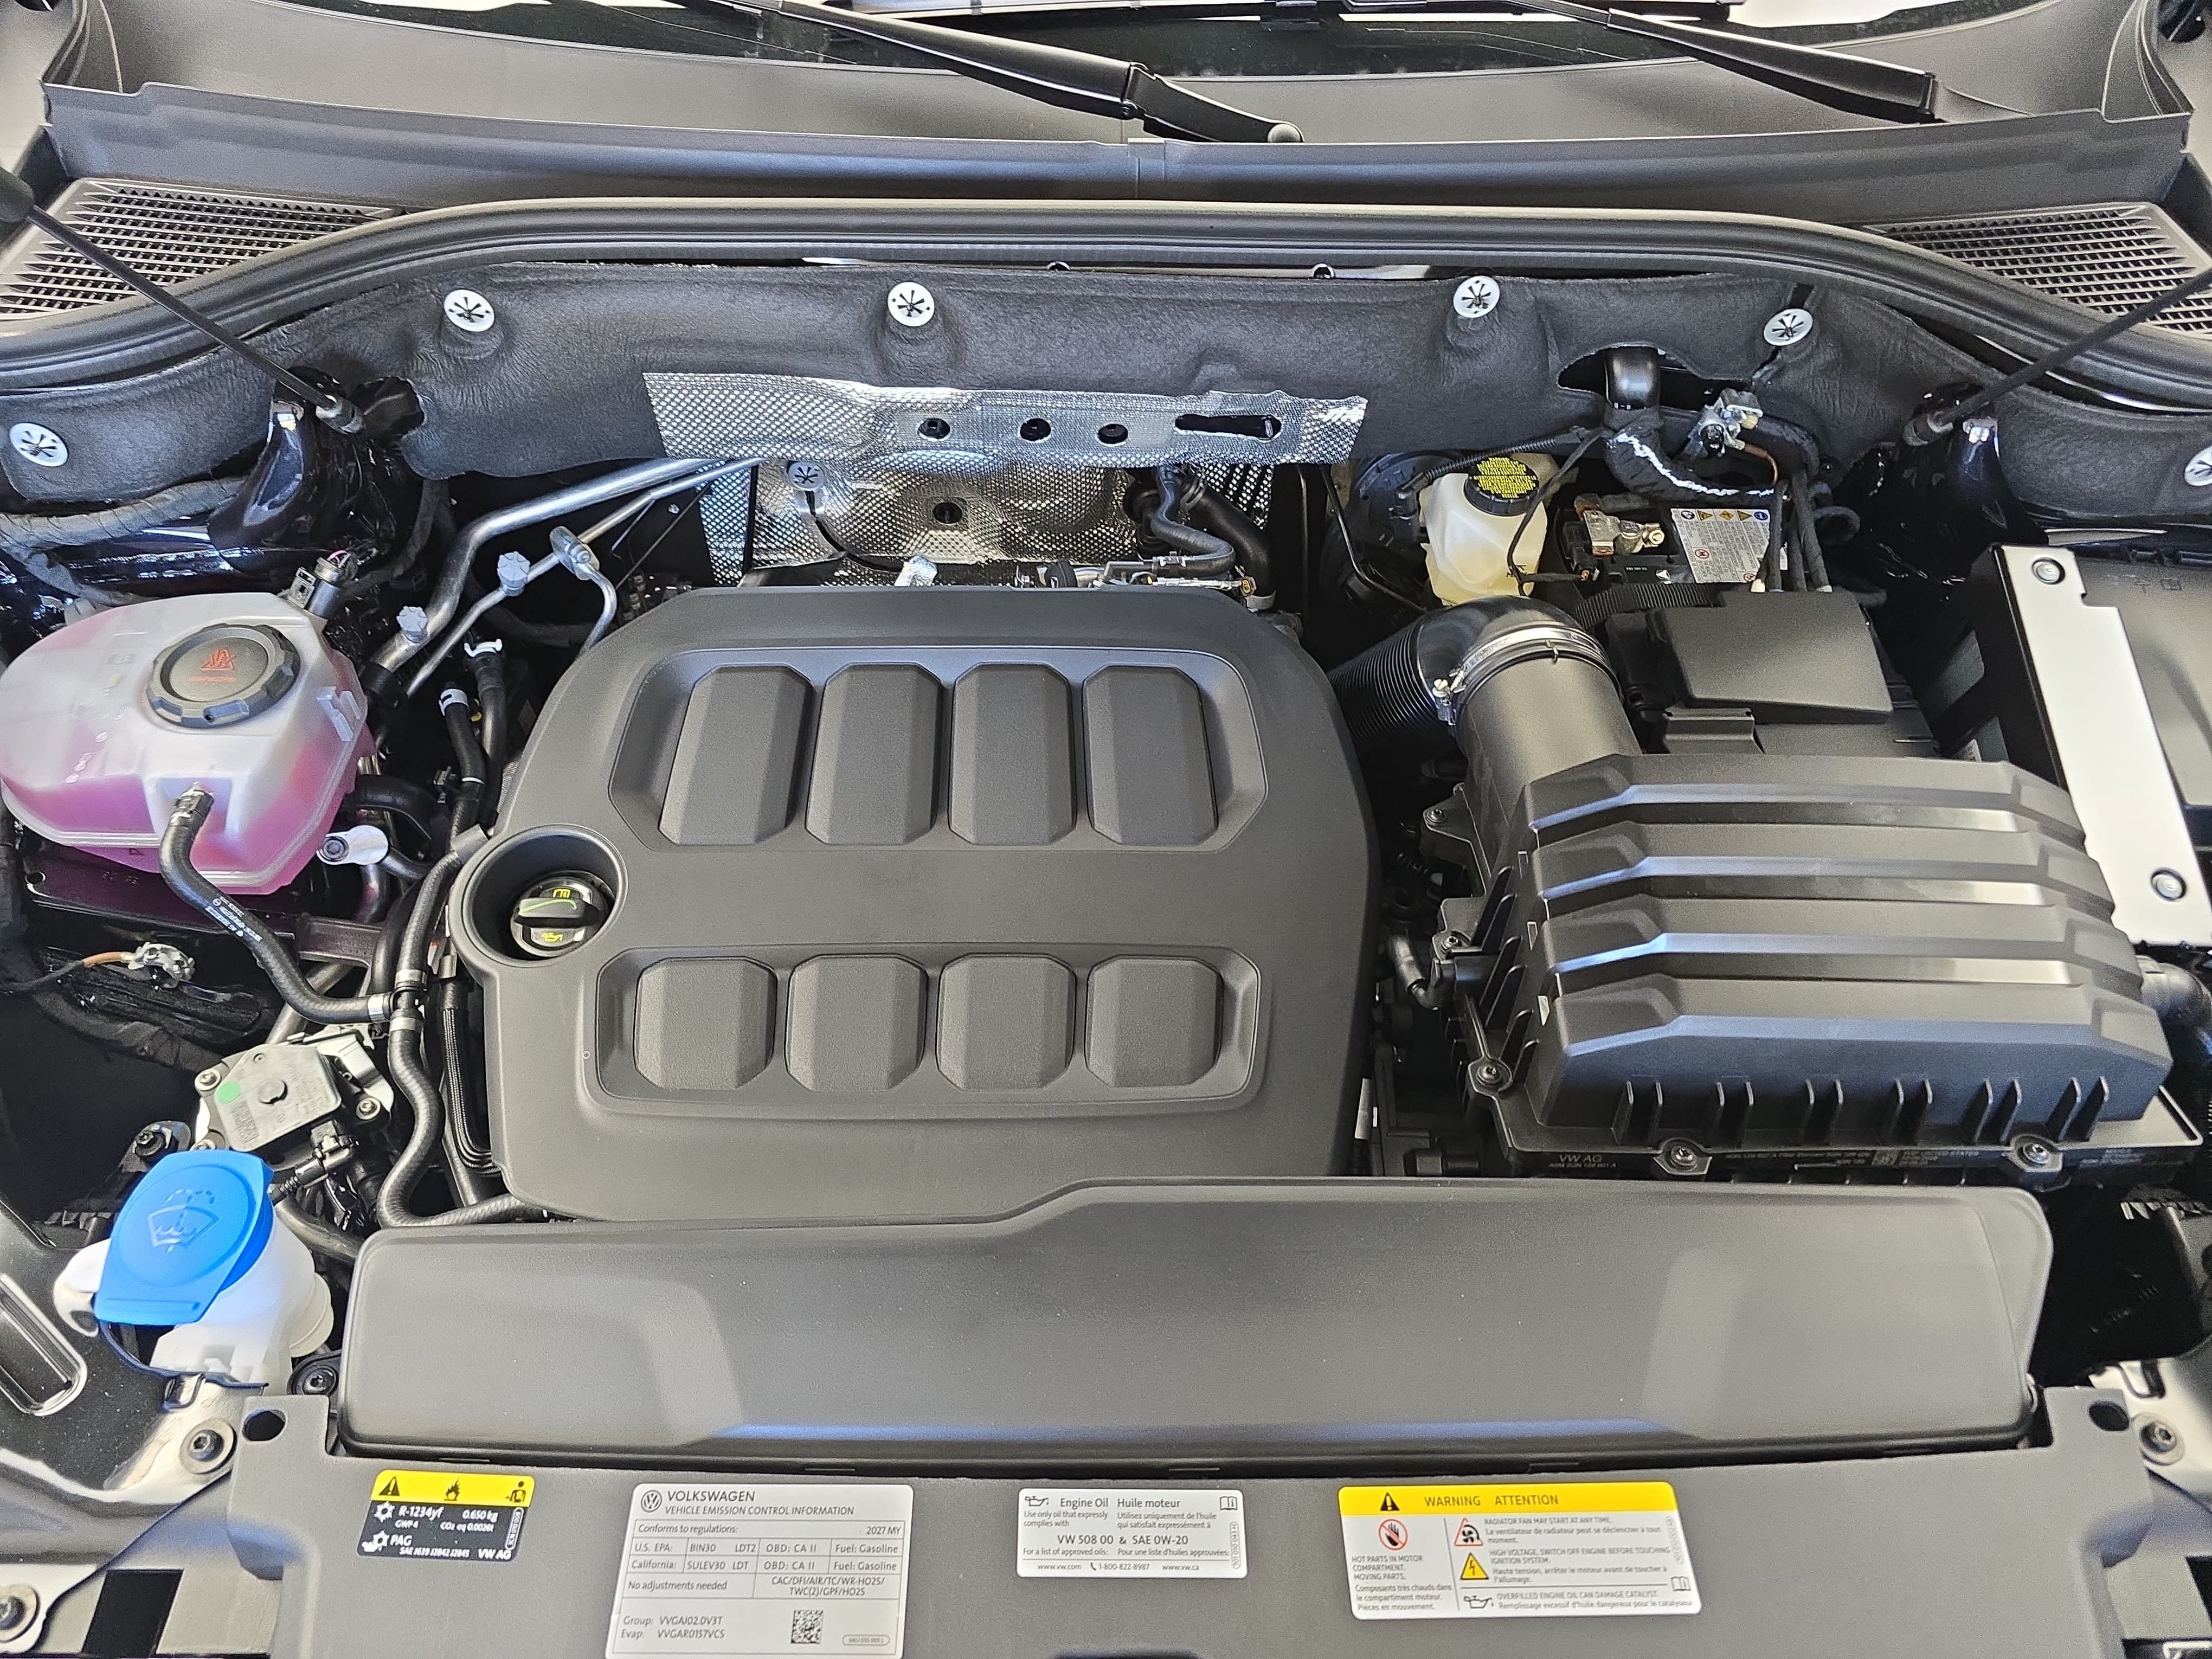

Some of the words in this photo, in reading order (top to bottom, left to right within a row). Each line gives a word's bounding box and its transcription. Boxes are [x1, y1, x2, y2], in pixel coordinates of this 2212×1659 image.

[1559, 1154, 1581, 1162] VW
[667, 1490, 755, 1502] VOLKSWAGEN
[1424, 1496, 1481, 1507] WARNING
[1495, 1495, 1559, 1506] ATTENTION
[1060, 1497, 1092, 1510] Engine
[1095, 1498, 1108, 1507] Oil
[1117, 1498, 1142, 1508] Huile
[1145, 1499, 1180, 1508] moteur
[399, 1506, 444, 1521] R-1234yf
[462, 1509, 487, 1520] 0.650
[487, 1510, 499, 1522] kg
[665, 1506, 701, 1514] VEHICLE
[703, 1506, 746, 1515] EMISSION
[748, 1506, 789, 1515] CONTROL
[792, 1506, 854, 1515] INFORMATION
[1038, 1510, 1052, 1519] only
[1078, 1511, 1108, 1520] expressly
[395, 1519, 413, 1528] GWP
[456, 1523, 466, 1533] eq
[1024, 1519, 1053, 1528] complies
[1117, 1521, 1128, 1529] qui
[639, 1523, 678, 1533] Conforms
[680, 1524, 689, 1533] to
[690, 1523, 738, 1535] regulations:
[866, 1526, 886, 1535] 2027
[888, 1526, 901, 1535] MY
[390, 1534, 412, 1546] PAG
[1057, 1535, 1075, 1544] VW
[1078, 1535, 1097, 1545] 508
[1100, 1535, 1114, 1545] 00
[1119, 1536, 1127, 1545] &
[1132, 1535, 1151, 1545] SAE
[1154, 1535, 1188, 1545] 0W-20
[400, 1547, 414, 1555] SAE
[635, 1543, 651, 1552] U.S.
[654, 1544, 673, 1552] EPA:
[690, 1544, 716, 1552] BIN30
[735, 1544, 756, 1552] LDT2
[766, 1544, 790, 1552] OBD:
[794, 1544, 806, 1553] CA
[810, 1544, 816, 1553] II
[835, 1544, 856, 1553] Fuel:
[859, 1544, 898, 1553] Gasoline
[1062, 1548, 1093, 1557] approved
[478, 1548, 496, 1559] VW
[496, 1549, 512, 1560] AG
[632, 1560, 676, 1570] California:
[687, 1561, 725, 1570] SULEV30
[733, 1561, 749, 1570] LDT
[764, 1561, 788, 1570] OBD:
[792, 1561, 805, 1570] CA
[808, 1561, 815, 1570] II
[834, 1561, 854, 1570] Fuel:
[858, 1561, 897, 1571] Gasoline
[628, 1581, 640, 1590] No
[642, 1580, 694, 1592] adjustments
[697, 1581, 728, 1590] needed
[789, 1587, 866, 1597] TWC(2)/GPF/HO2S
[623, 1615, 654, 1627] Group:
[621, 1629, 645, 1641] Evap:
